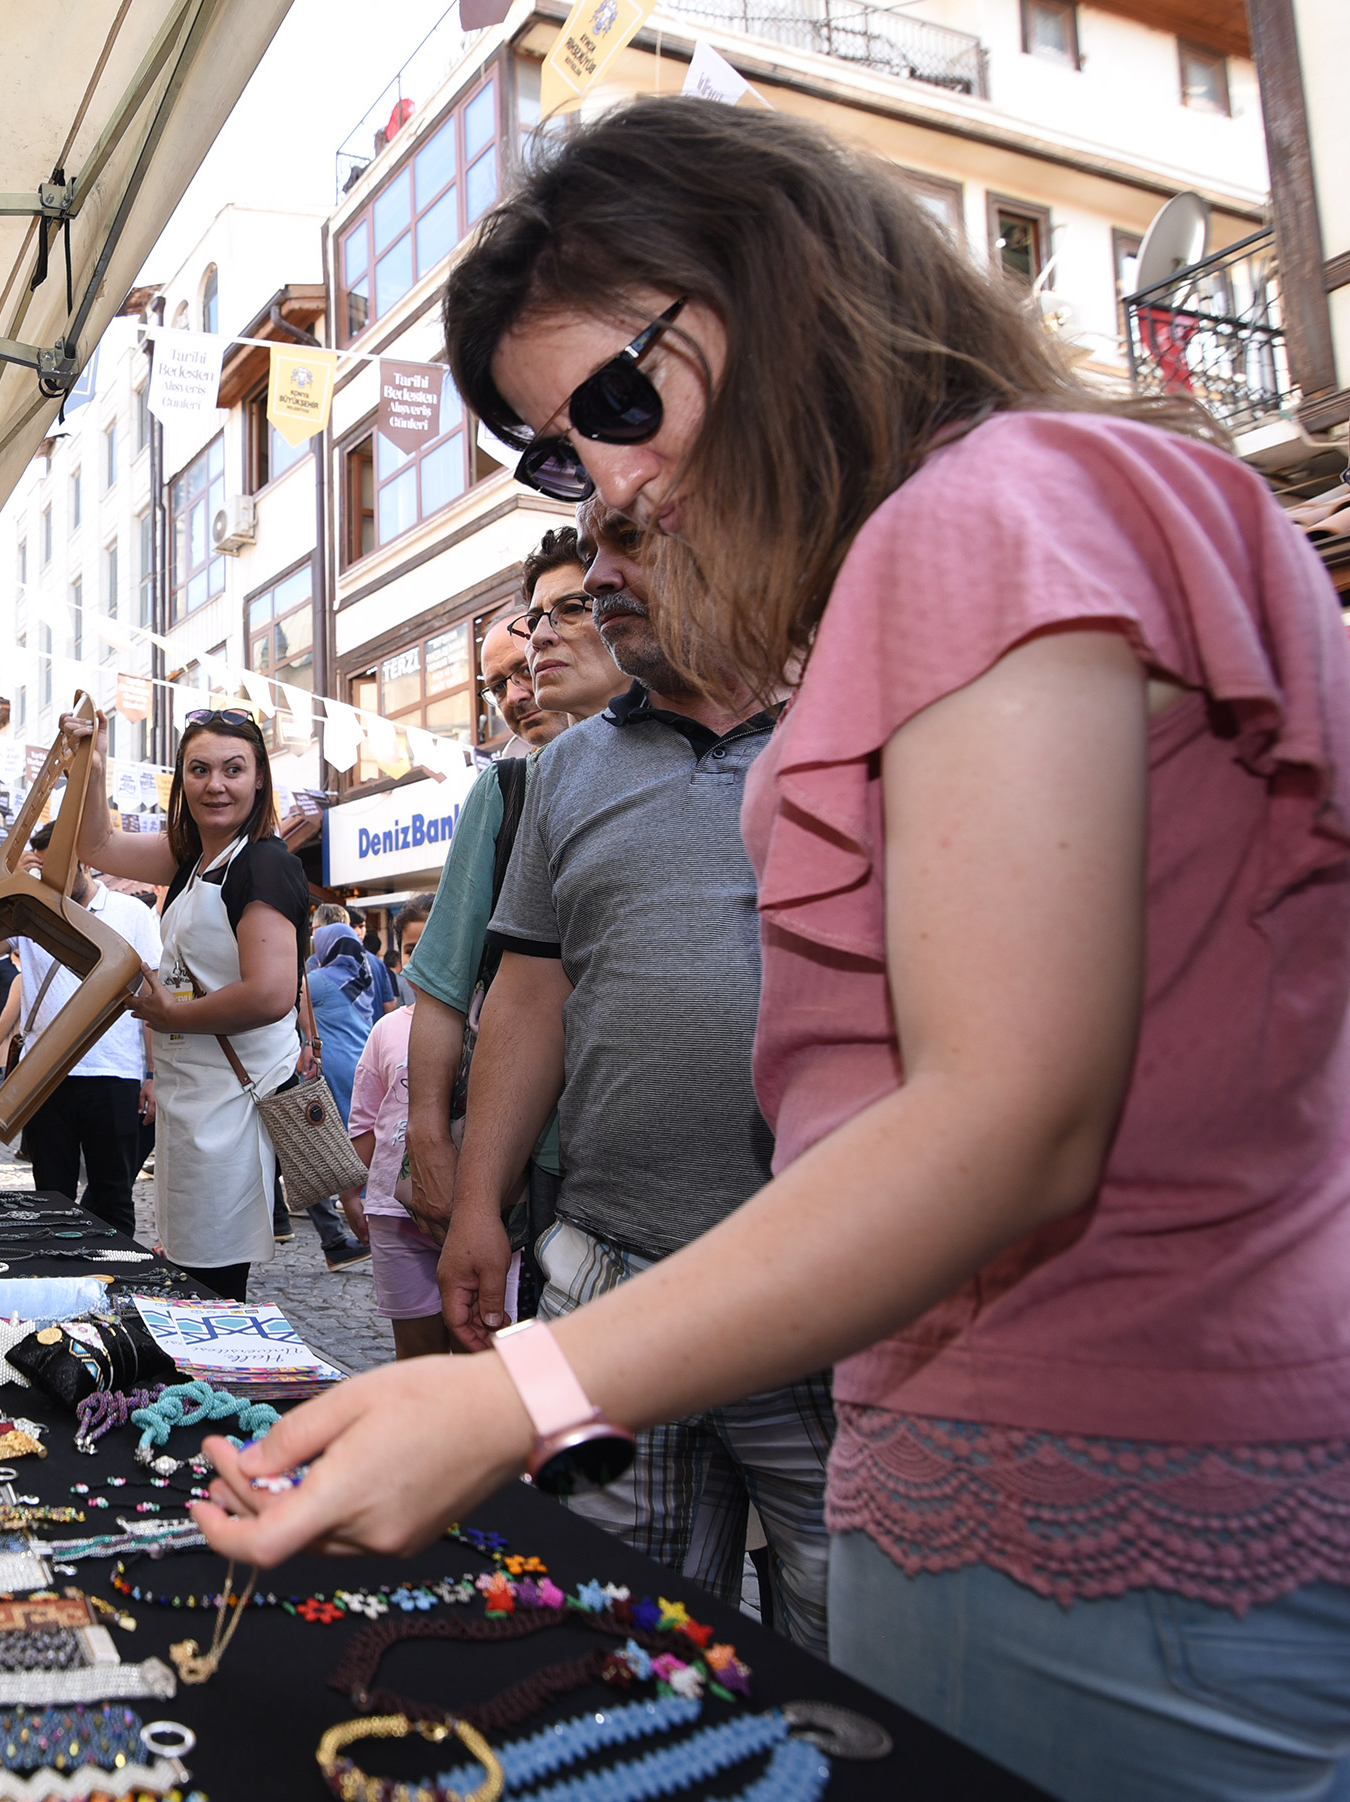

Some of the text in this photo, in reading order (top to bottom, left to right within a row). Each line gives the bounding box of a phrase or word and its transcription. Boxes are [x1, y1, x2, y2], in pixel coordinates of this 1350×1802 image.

[171, 348, 207, 364] Tarihi
[158, 363, 214, 382] Bedesten
[393, 372, 430, 388] Tarihi
[383, 385, 438, 405] Bedesten
[161, 396, 202, 411] Günleri
[387, 403, 432, 418] Alışveriş
[389, 416, 430, 431] Günleri
